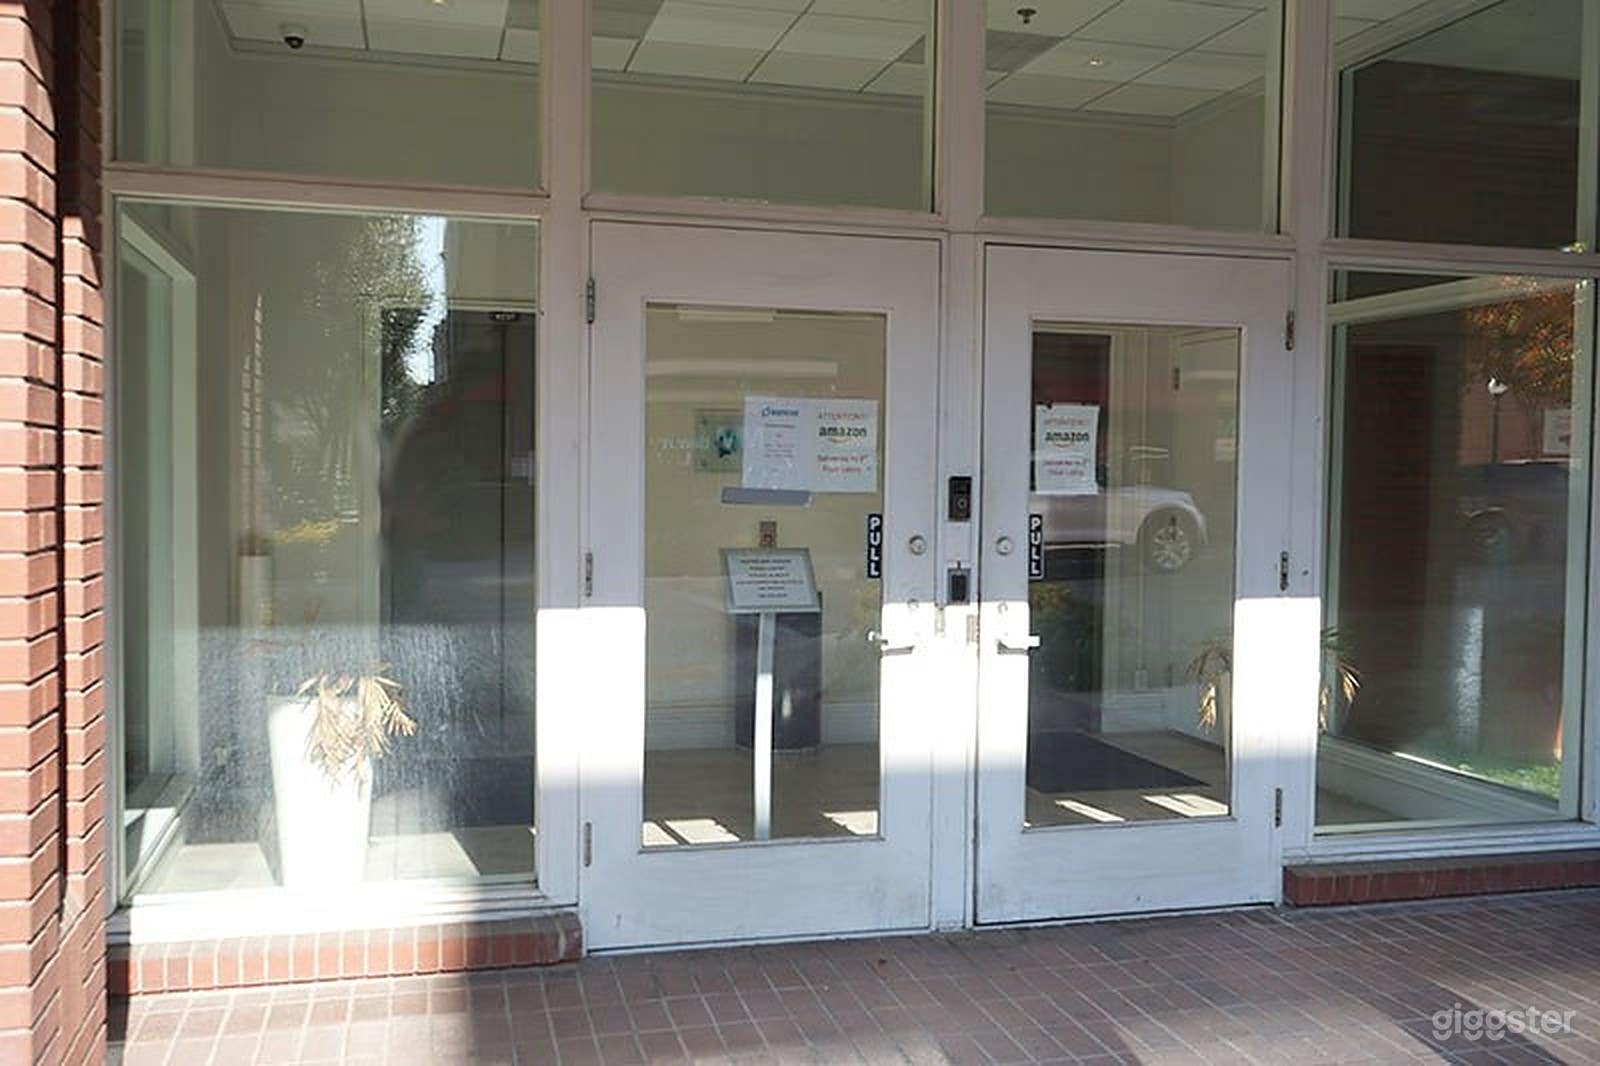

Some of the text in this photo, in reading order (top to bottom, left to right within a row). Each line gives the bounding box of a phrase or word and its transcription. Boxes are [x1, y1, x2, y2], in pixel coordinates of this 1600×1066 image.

[819, 426, 867, 437] amazon
[1045, 431, 1090, 441] amazon
[870, 517, 880, 576] PULL
[1031, 516, 1041, 574] PULL
